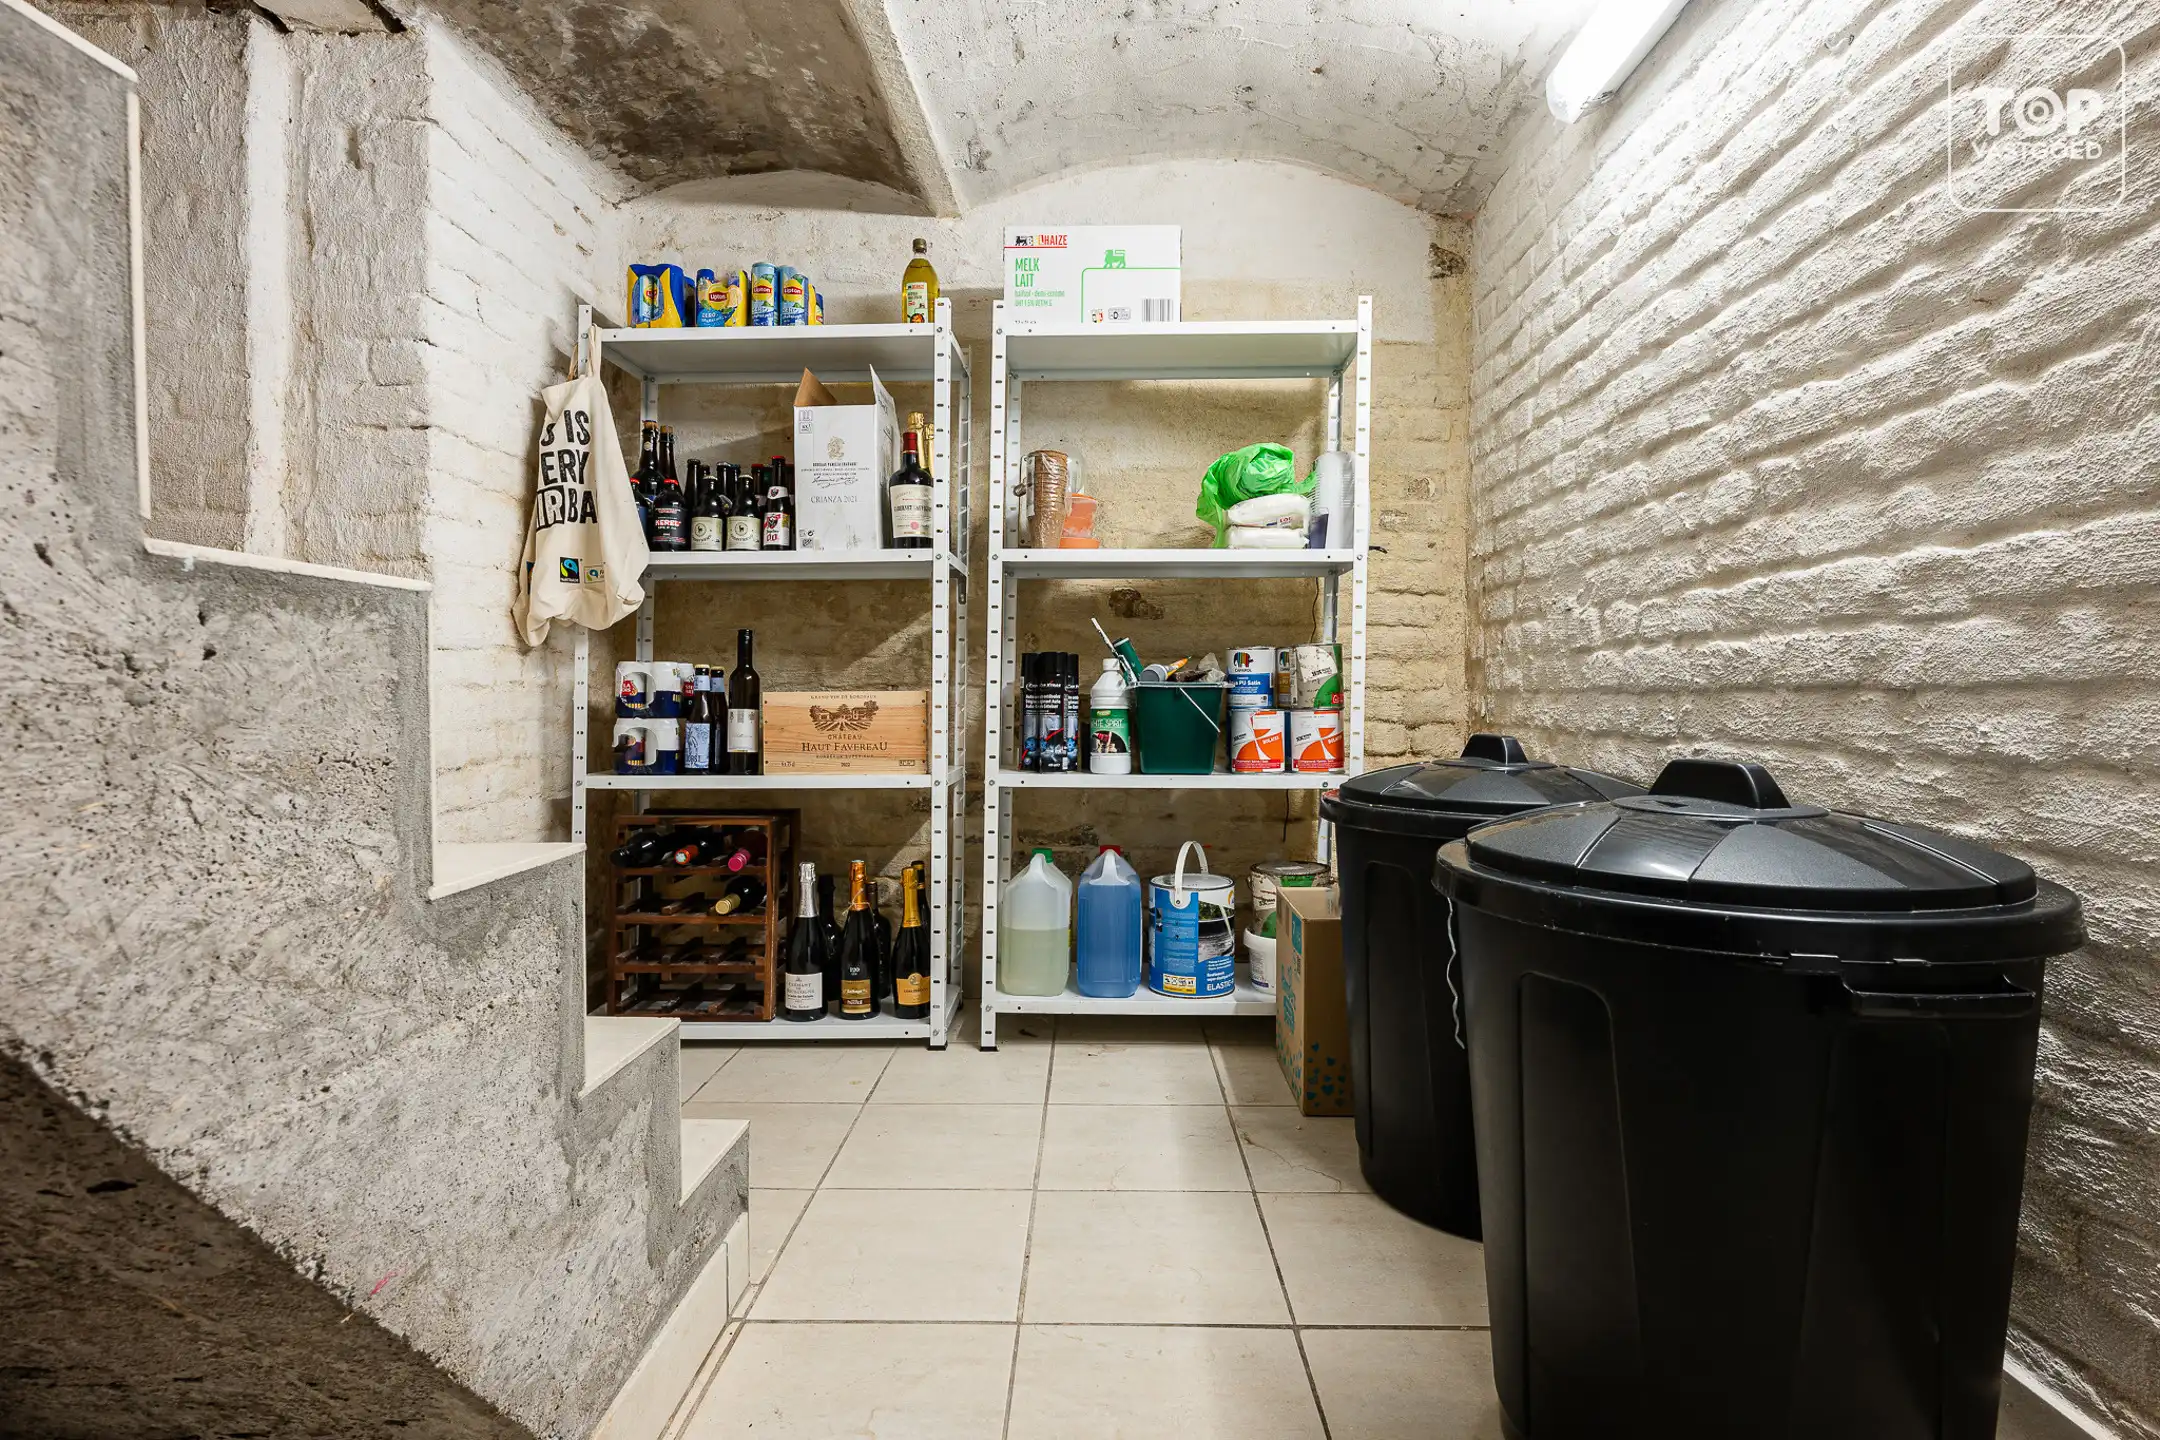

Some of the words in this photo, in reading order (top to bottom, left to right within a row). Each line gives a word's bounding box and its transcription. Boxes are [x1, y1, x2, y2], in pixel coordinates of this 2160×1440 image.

[1015, 258, 1040, 272] MELK
[1015, 274, 1035, 287] LAIT
[784, 287, 801, 295] Lipton
[564, 409, 590, 446] IS
[811, 495, 842, 504] CRIANZA
[844, 495, 858, 503] 2021
[828, 732, 863, 740] CHÂTEAU
[801, 742, 831, 752] HAUT
[834, 741, 888, 751] FAVEREAU
